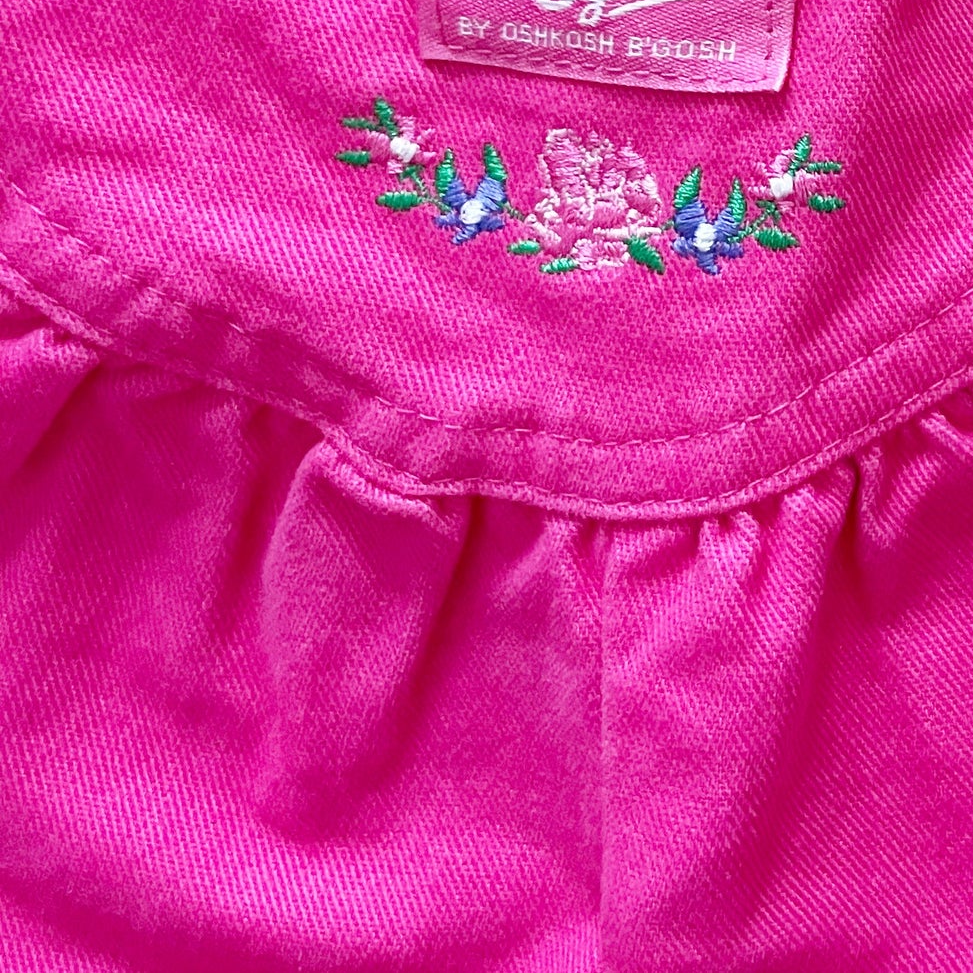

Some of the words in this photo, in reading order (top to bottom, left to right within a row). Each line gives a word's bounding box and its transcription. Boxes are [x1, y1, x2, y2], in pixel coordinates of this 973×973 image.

[456, 16, 491, 39] BY
[499, 23, 615, 54] OSHKOSH
[626, 37, 737, 61] B'GOSH
